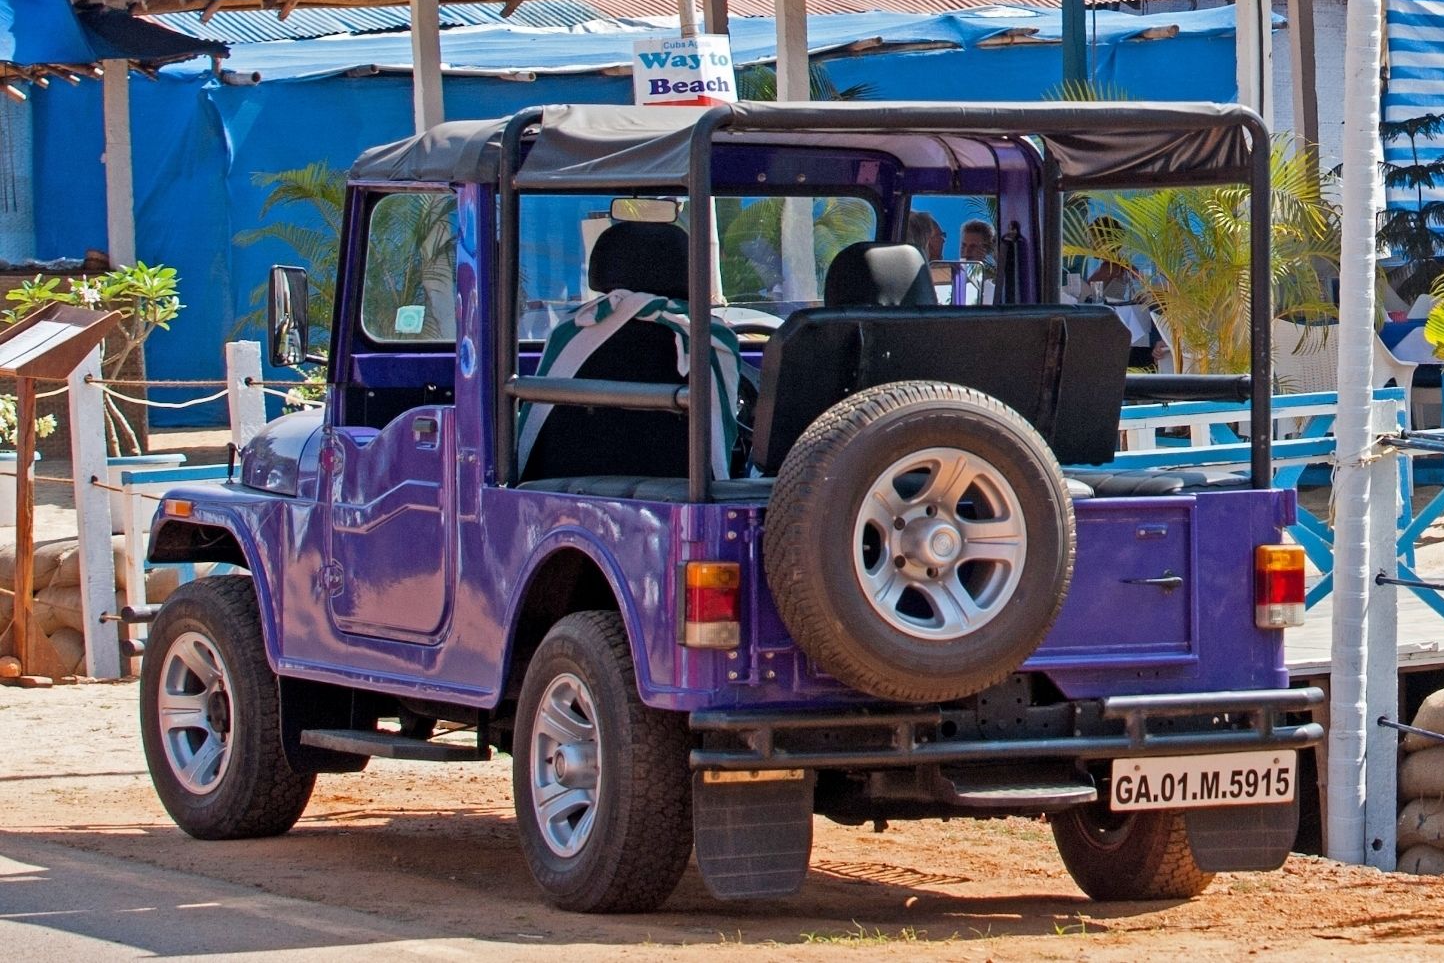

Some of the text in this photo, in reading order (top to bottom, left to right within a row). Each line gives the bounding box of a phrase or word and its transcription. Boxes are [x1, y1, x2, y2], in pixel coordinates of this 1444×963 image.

[663, 41, 686, 49] Cuba
[638, 51, 729, 70] Way to
[649, 76, 730, 95] Beach
[1115, 767, 1290, 805] GA.01.M.5915
